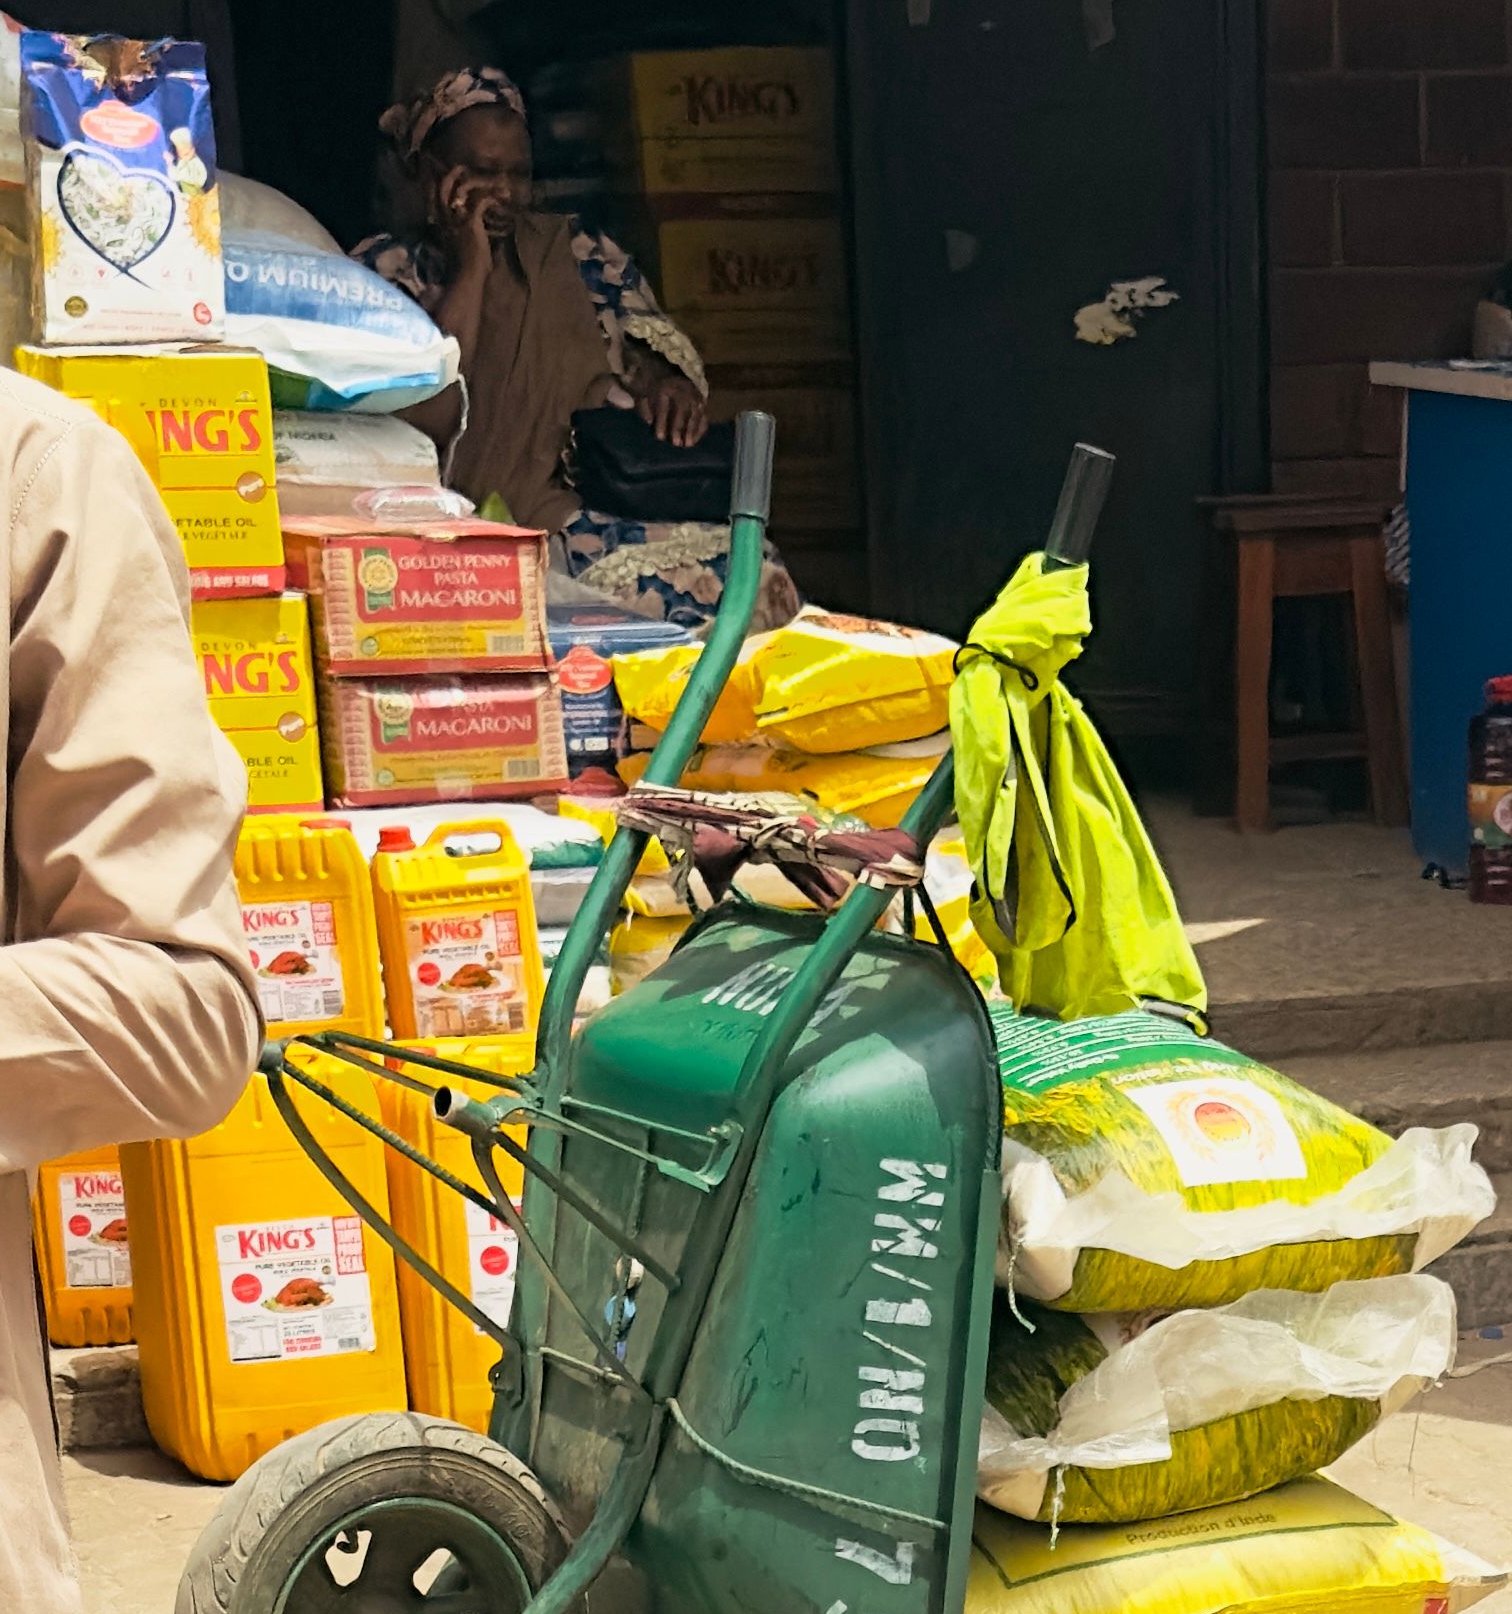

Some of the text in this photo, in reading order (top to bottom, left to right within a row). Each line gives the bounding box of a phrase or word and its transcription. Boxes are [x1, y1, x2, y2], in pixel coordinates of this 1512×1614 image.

[258, 263, 403, 312] PREMIUM
[159, 398, 217, 408] DEVON
[176, 518, 257, 528] ETABLE OIL
[398, 553, 512, 570] GOLDEN PENNY
[434, 571, 478, 586] PASTA
[400, 588, 516, 609] MACARONI
[201, 642, 257, 652] DEVON
[203, 651, 300, 695] NG'S
[416, 714, 532, 737] MACARONI
[278, 756, 298, 766] OIL
[242, 909, 299, 933] KING'S
[421, 919, 483, 945] KING'S
[75, 1176, 123, 1199] KING
[238, 1227, 316, 1259] KING'S
[1126, 1511, 1276, 1545] Production d'Inde
